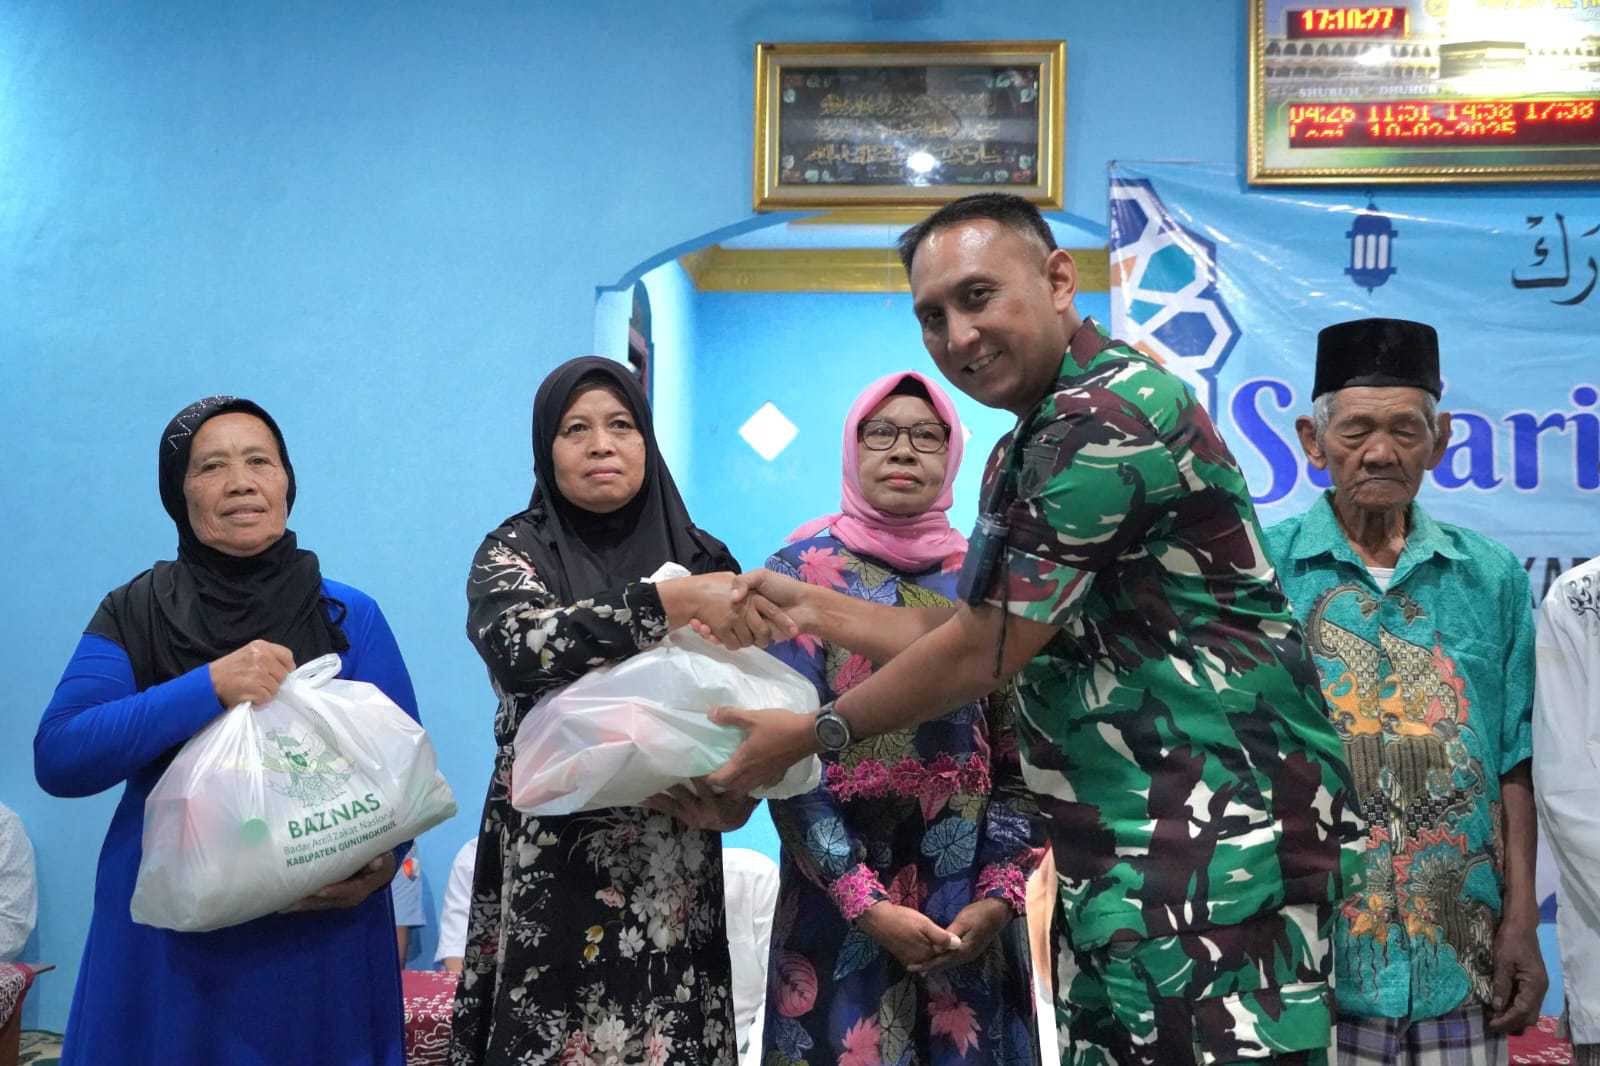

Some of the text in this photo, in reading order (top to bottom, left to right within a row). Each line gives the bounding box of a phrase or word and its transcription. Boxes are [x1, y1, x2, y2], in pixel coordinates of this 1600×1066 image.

[1233, 378, 1600, 504] Sari
[287, 793, 381, 839] BAZNAS
[286, 820, 397, 868] KABUPATEN GUNUNGKIDUL
